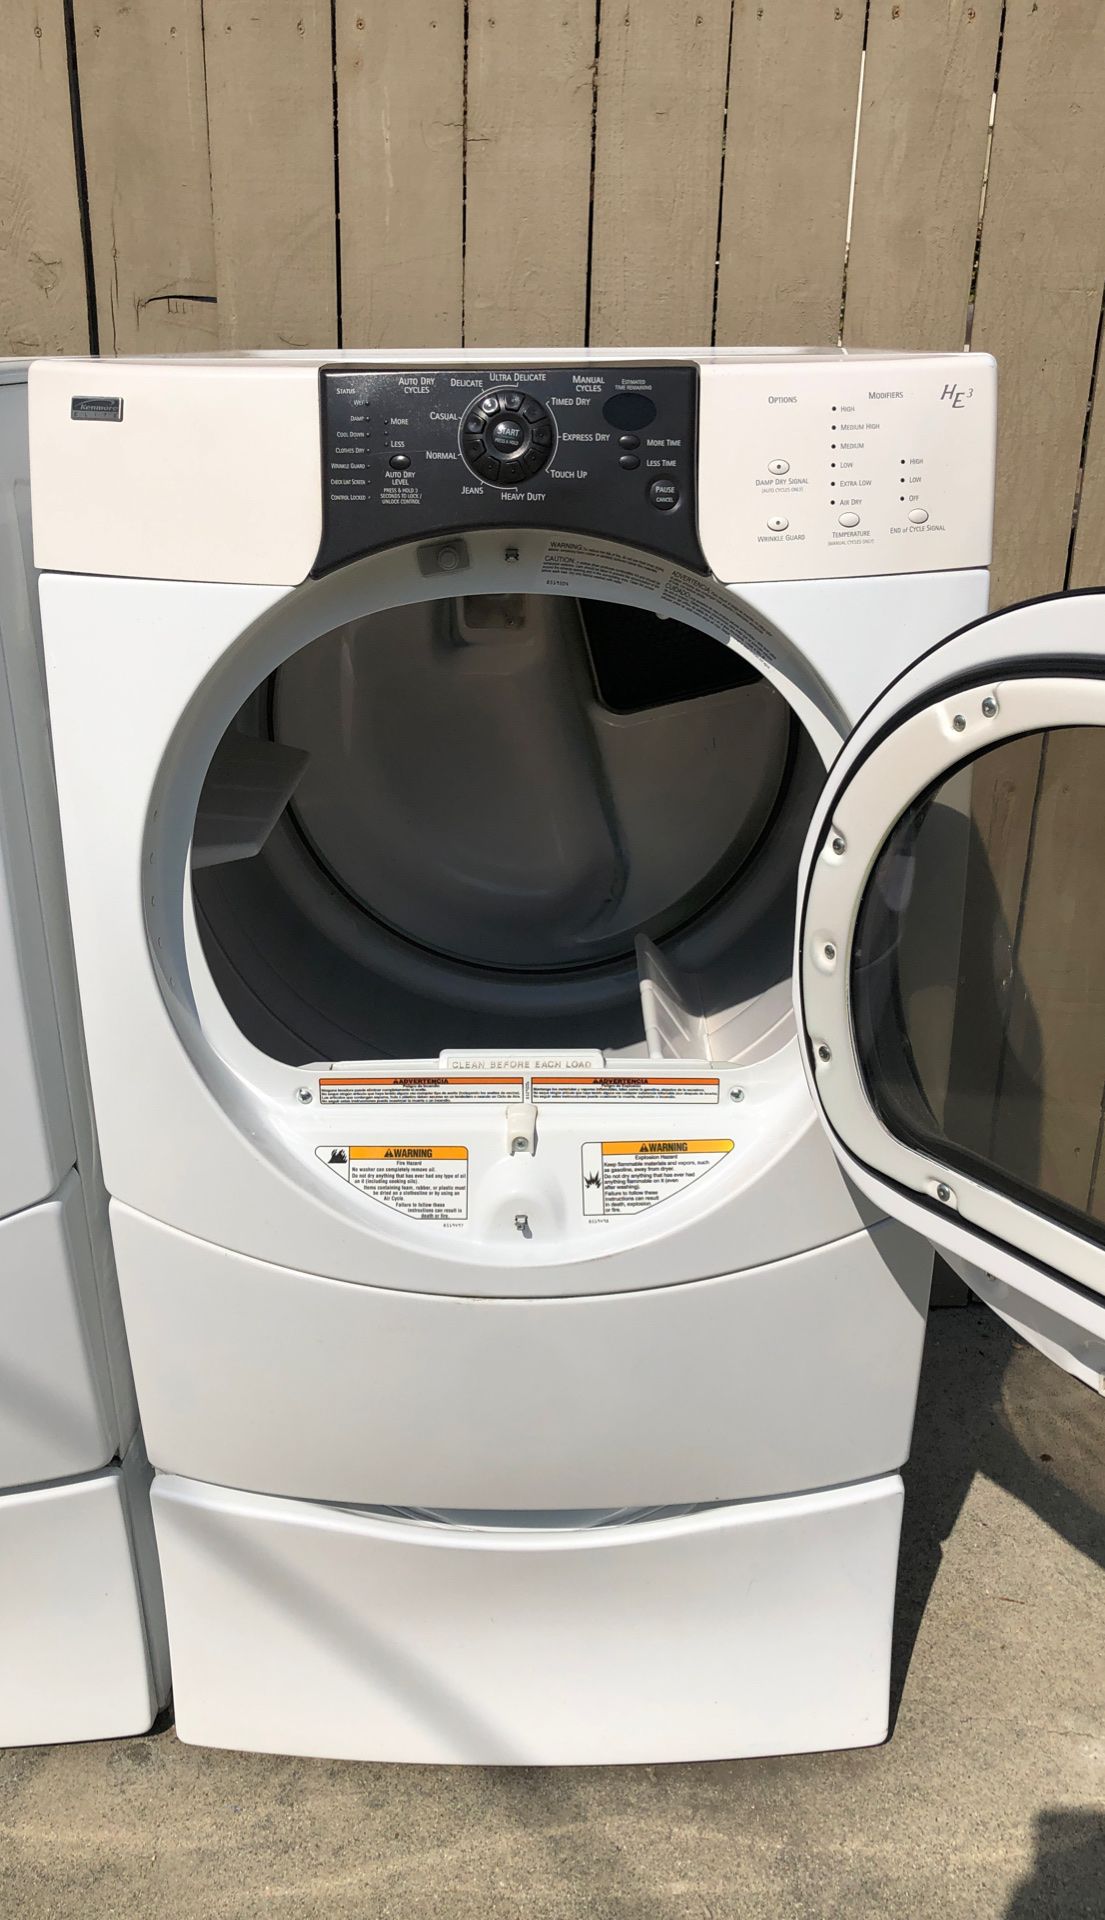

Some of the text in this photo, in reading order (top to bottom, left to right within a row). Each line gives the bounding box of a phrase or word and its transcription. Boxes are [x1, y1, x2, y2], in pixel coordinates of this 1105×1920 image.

[398, 377, 419, 386] AUTO
[489, 373, 546, 382] ULTRA DELICATE
[572, 376, 605, 385] MANUAL
[450, 378, 483, 387] DELICATE
[768, 396, 797, 404] OPTIONS
[868, 391, 904, 400] MODIFIERS
[552, 398, 591, 406] TIMED DRY
[429, 412, 457, 420] CASUAL
[562, 433, 610, 442] EXPRESS DRY
[646, 438, 681, 447] MORE TIME
[426, 451, 457, 460] NORMAL
[550, 470, 588, 479] TOUCH UP
[461, 486, 484, 495] JEANS
[501, 492, 546, 501] HEAVY DUTY
[832, 530, 870, 539] TEMPERATURE
[452, 1061, 485, 1069] CLEAN
[490, 1060, 530, 1069] BEFORE
[648, 1143, 688, 1152] WARNING
[394, 1149, 432, 1158] WARNING
